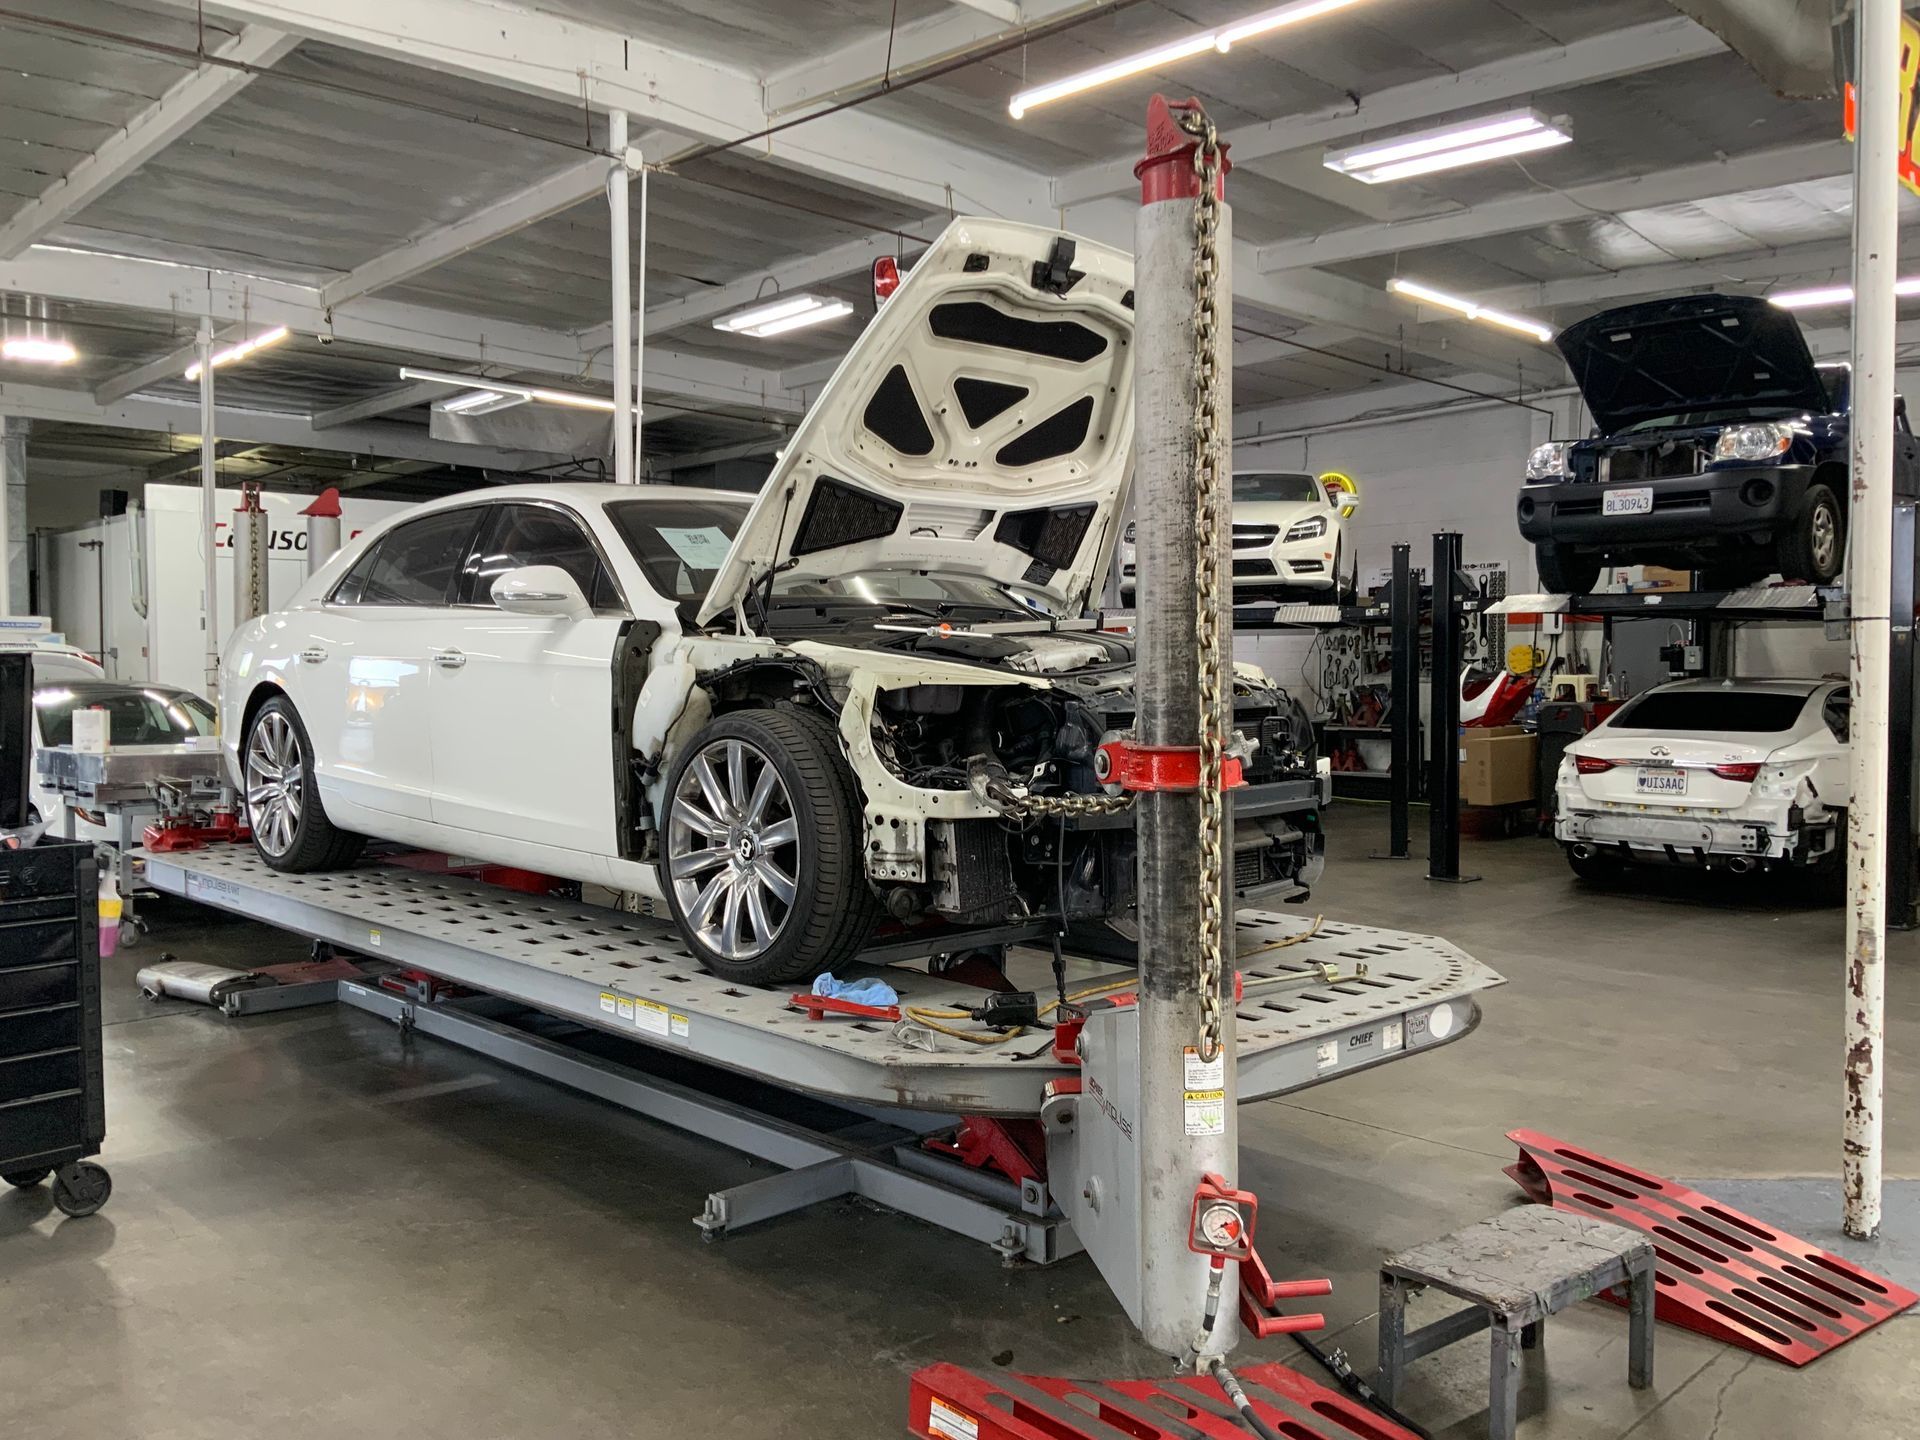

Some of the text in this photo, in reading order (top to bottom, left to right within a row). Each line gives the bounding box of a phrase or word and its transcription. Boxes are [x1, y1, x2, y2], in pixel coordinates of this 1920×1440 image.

[1606, 497, 1649, 512] 8L30943
[1350, 1031, 1373, 1047] CHIEF
[1195, 1091, 1222, 1100] CAUTION
